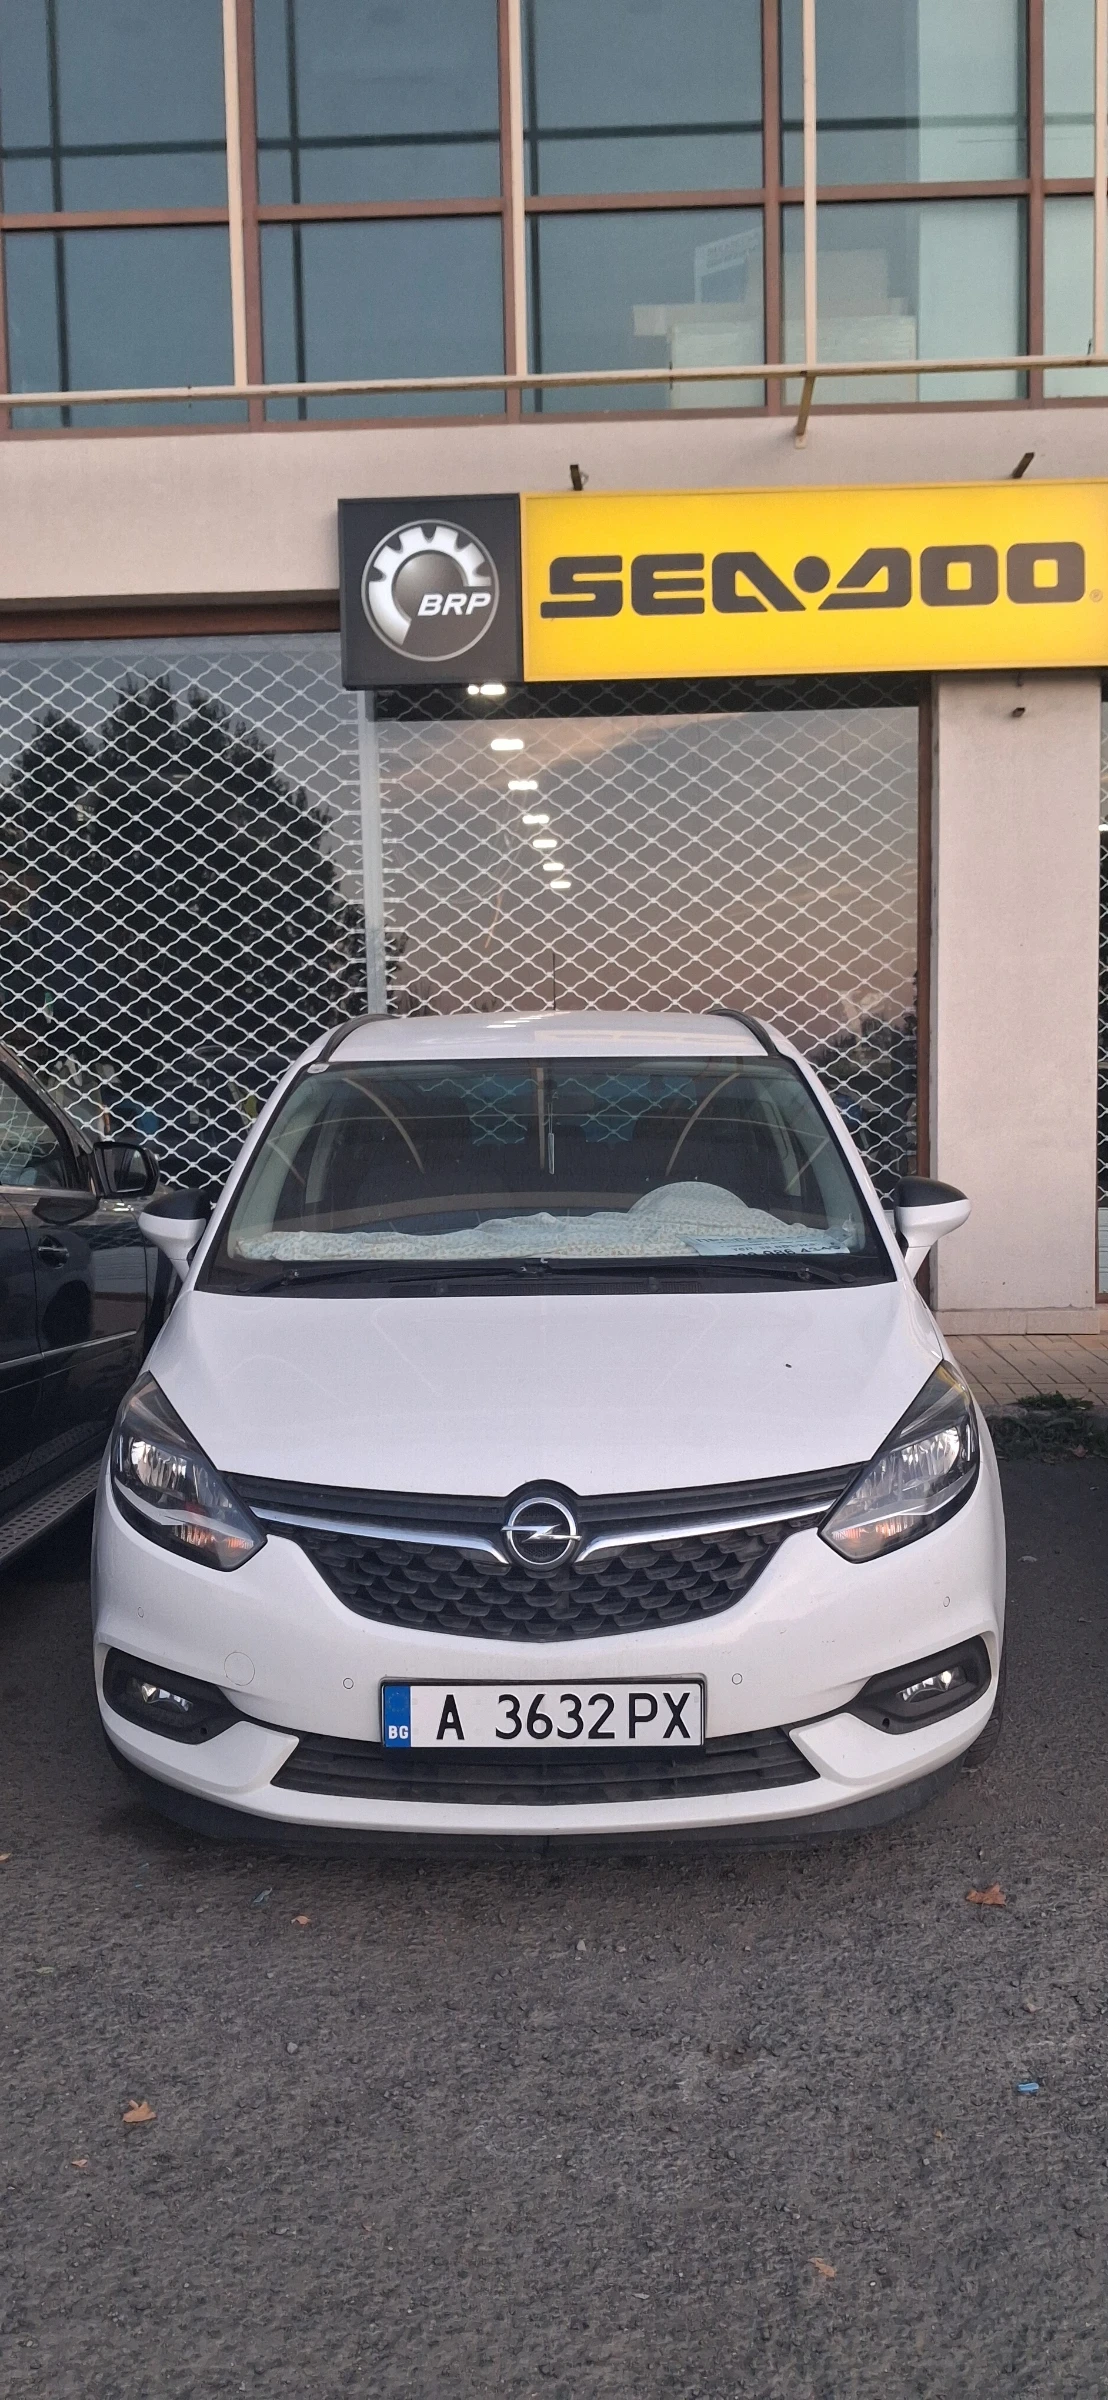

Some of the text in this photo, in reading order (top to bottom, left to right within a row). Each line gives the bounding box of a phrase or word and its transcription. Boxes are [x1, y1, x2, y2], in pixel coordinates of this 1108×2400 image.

[417, 592, 491, 616] BRP
[436, 1694, 465, 1740] A
[388, 1725, 409, 1739] BG
